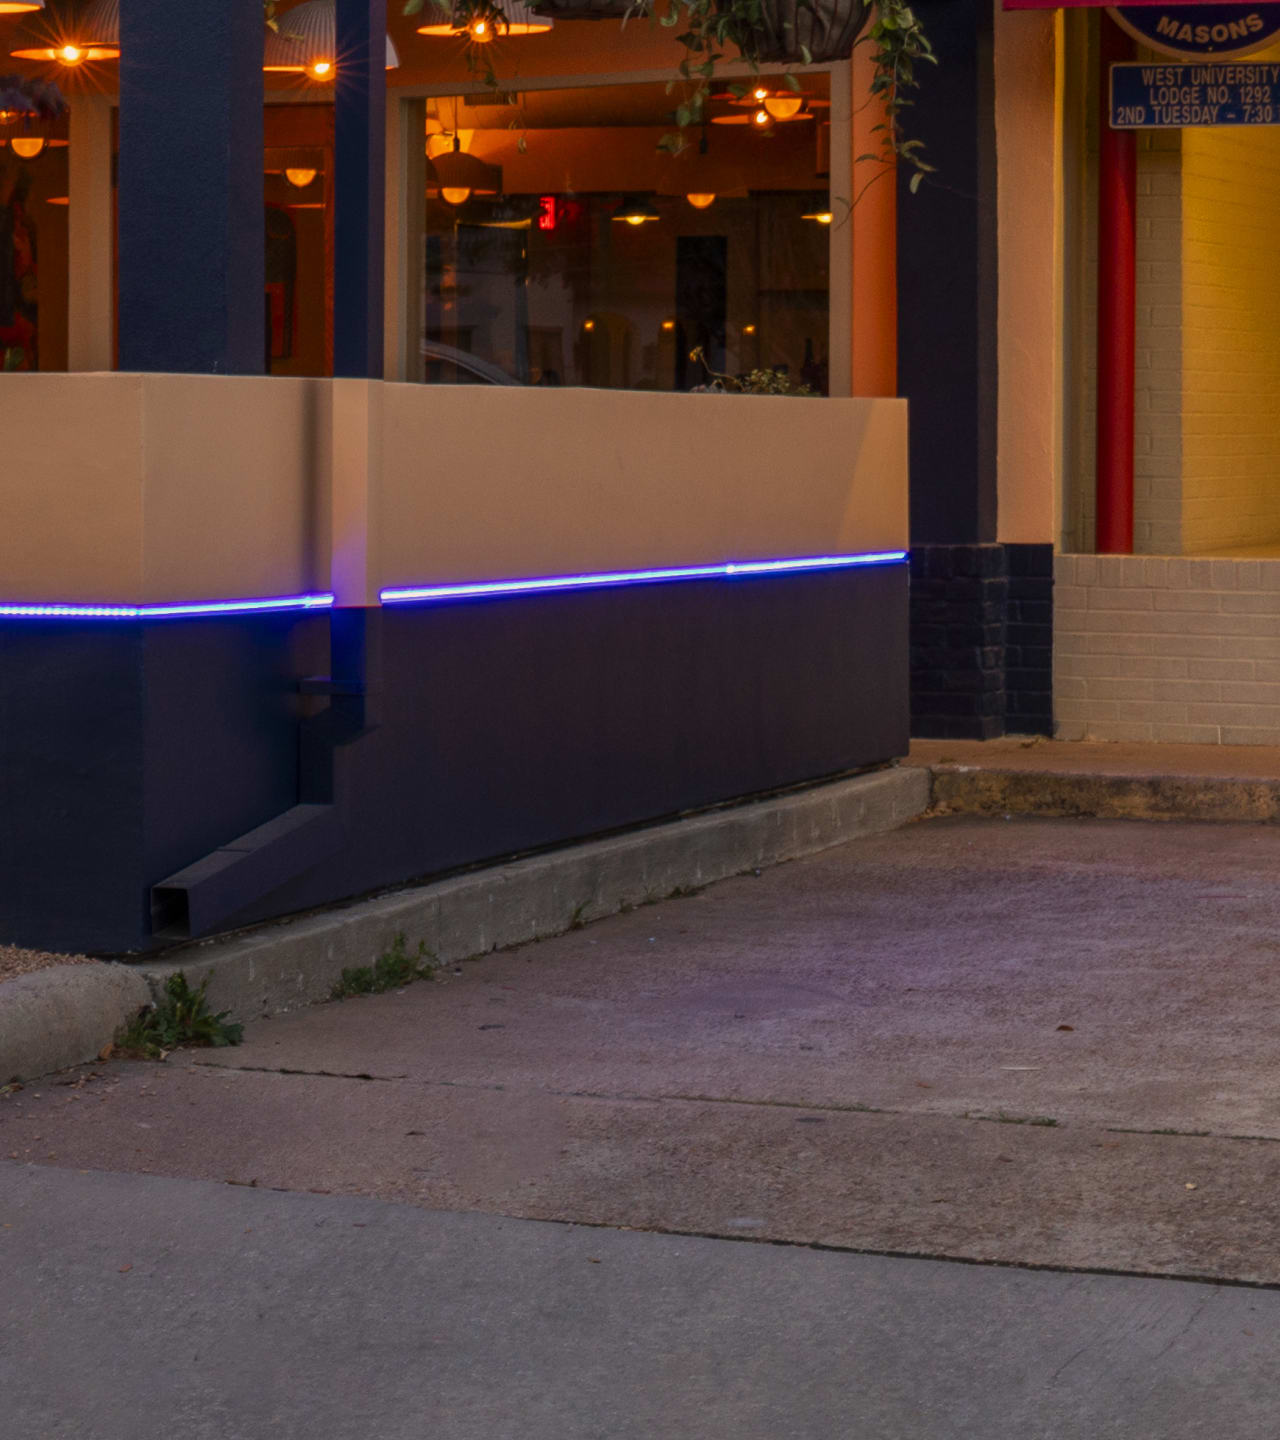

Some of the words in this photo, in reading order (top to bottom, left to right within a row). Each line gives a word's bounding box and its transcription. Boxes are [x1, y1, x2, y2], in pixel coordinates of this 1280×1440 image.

[1156, 13, 1264, 44] MASONS
[1142, 67, 1184, 85] WEST
[1191, 65, 1278, 85] UNIVERSITY
[1150, 86, 1200, 105] LODGE
[1207, 86, 1232, 104] NO.
[1240, 85, 1271, 104] 1292
[1116, 106, 1146, 124] 2ND
[1152, 105, 1219, 124] TUESDAY
[1242, 105, 1272, 123] 7:30
